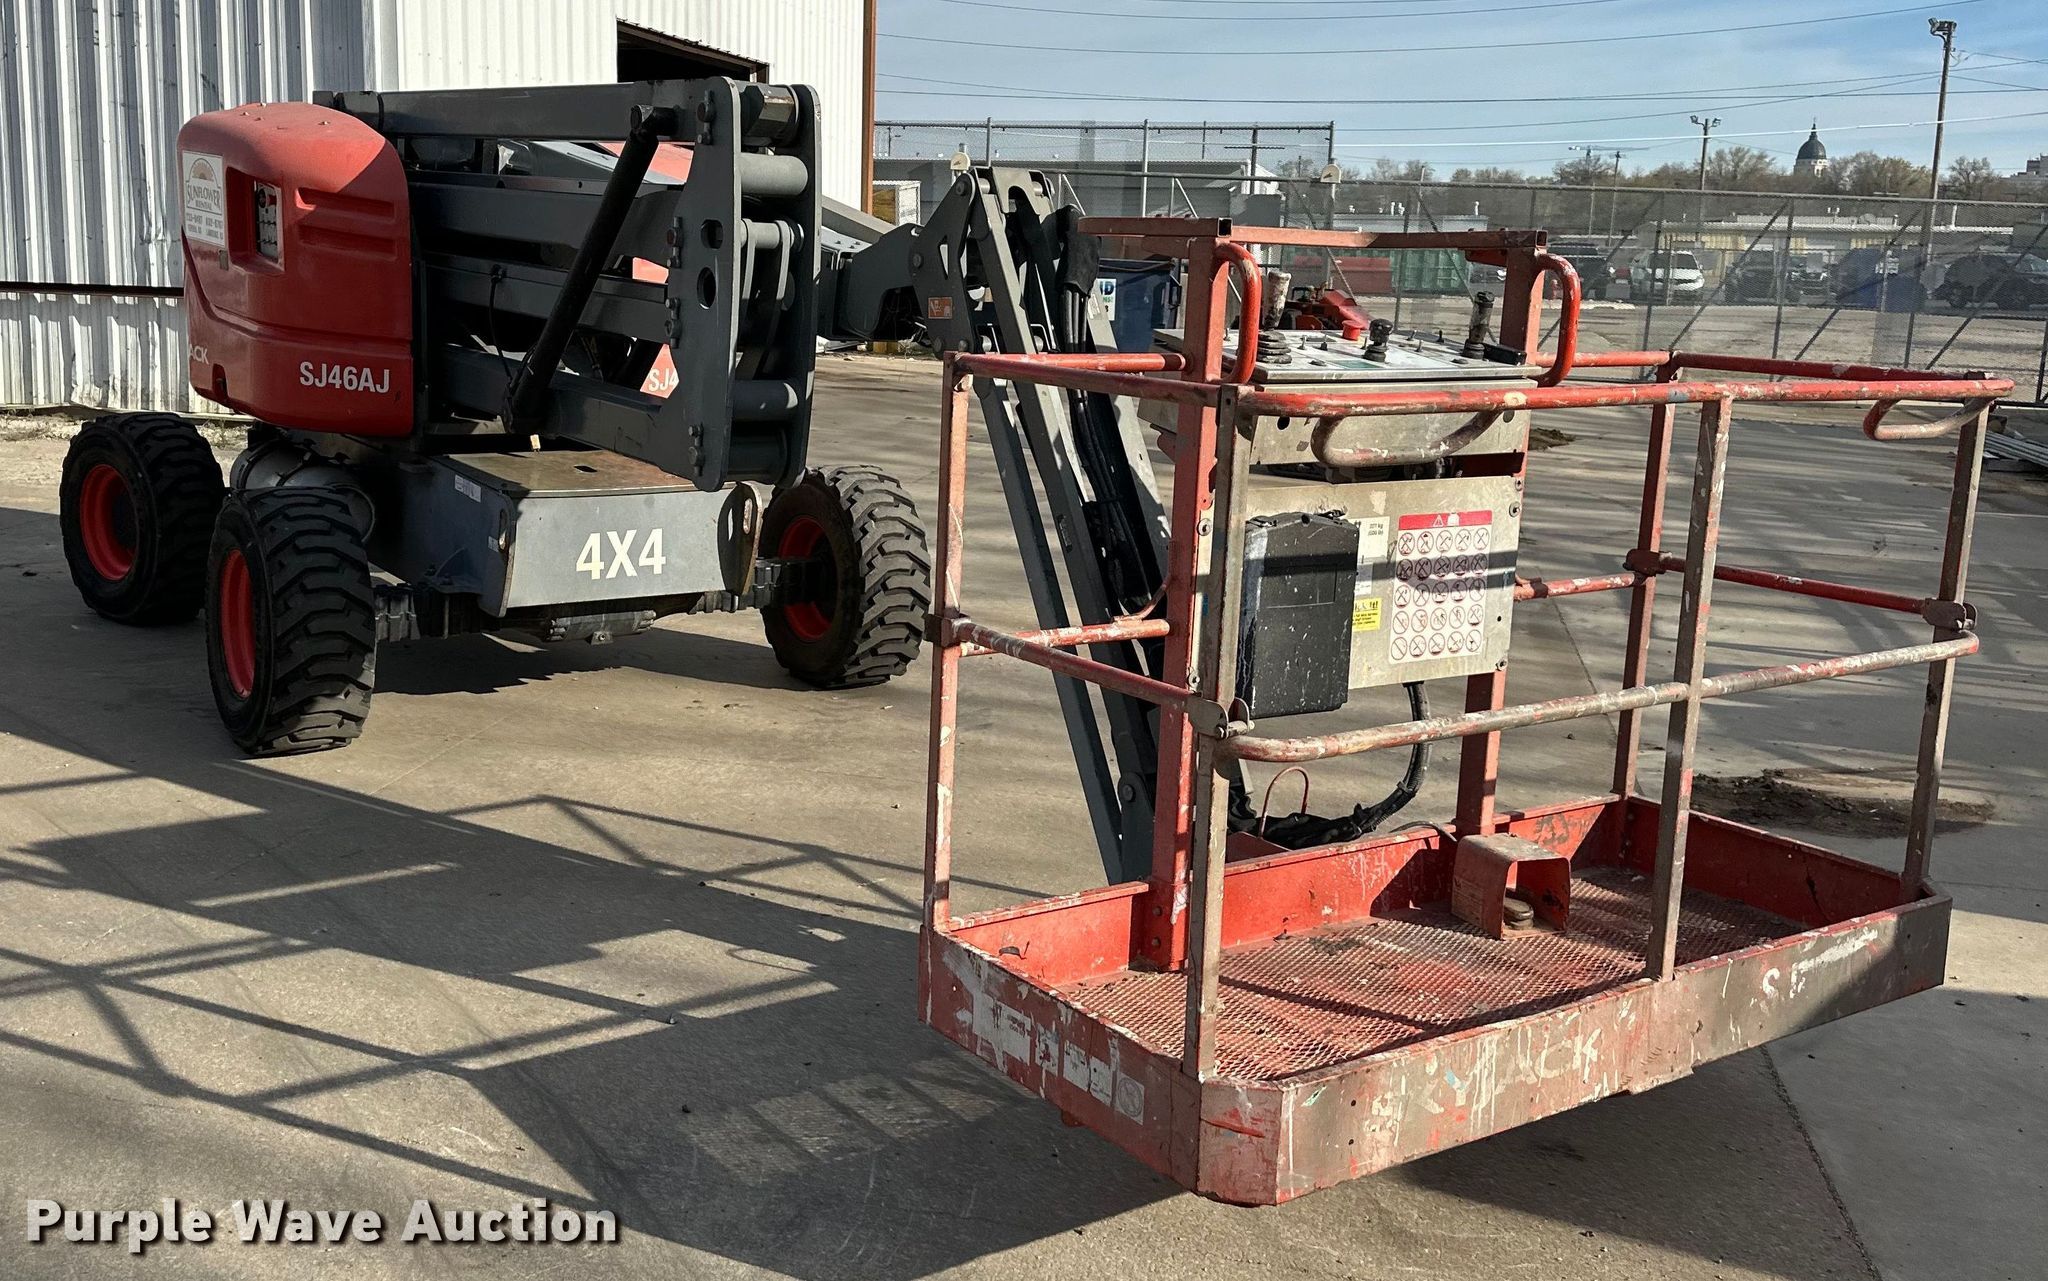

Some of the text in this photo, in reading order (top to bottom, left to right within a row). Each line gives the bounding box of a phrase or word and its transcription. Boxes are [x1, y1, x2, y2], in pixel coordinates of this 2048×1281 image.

[187, 184, 220, 210] SUNFLOWER
[300, 361, 390, 393] SJ46AJ
[576, 528, 666, 580] 4X4
